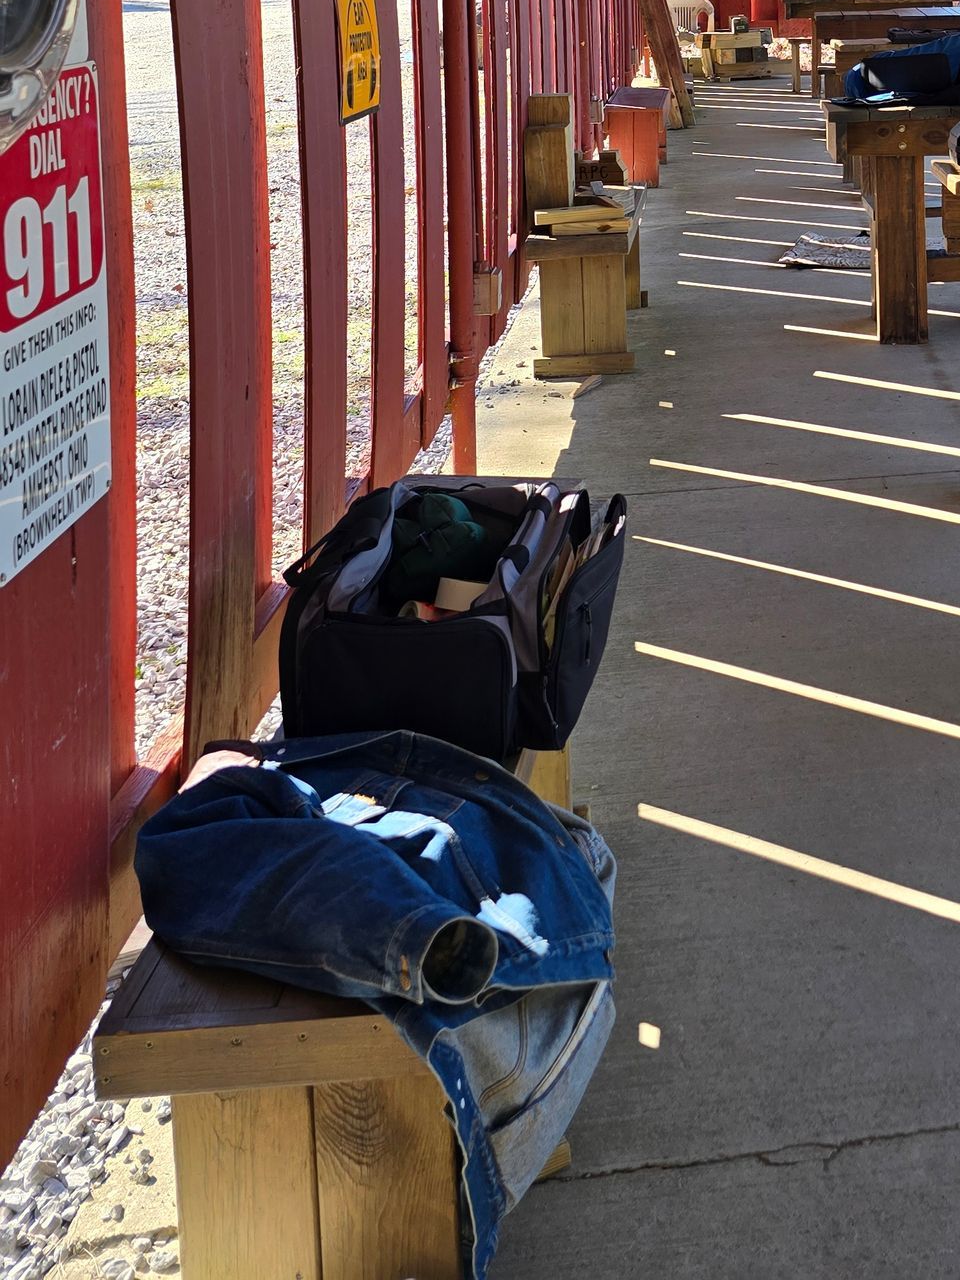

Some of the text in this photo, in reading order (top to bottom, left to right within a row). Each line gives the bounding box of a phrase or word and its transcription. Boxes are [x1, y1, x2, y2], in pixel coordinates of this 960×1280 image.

[349, 31, 372, 53] PROTECTION
[353, 2, 365, 25] EAR
[27, 73, 91, 130] GENCY?
[30, 128, 66, 179] DIAL
[3, 176, 93, 319] 911
[4, 302, 97, 372] GIVE THEM THIS INFO:
[3, 338, 99, 437] LORAIN RIFLE & PISTOL
[27, 410, 59, 469] NORTH
[60, 393, 85, 444] RIDGE
[86, 377, 107, 424] ROAD
[68, 432, 88, 481] OHIO
[13, 470, 95, 568] (BROWNHELM TWP)
